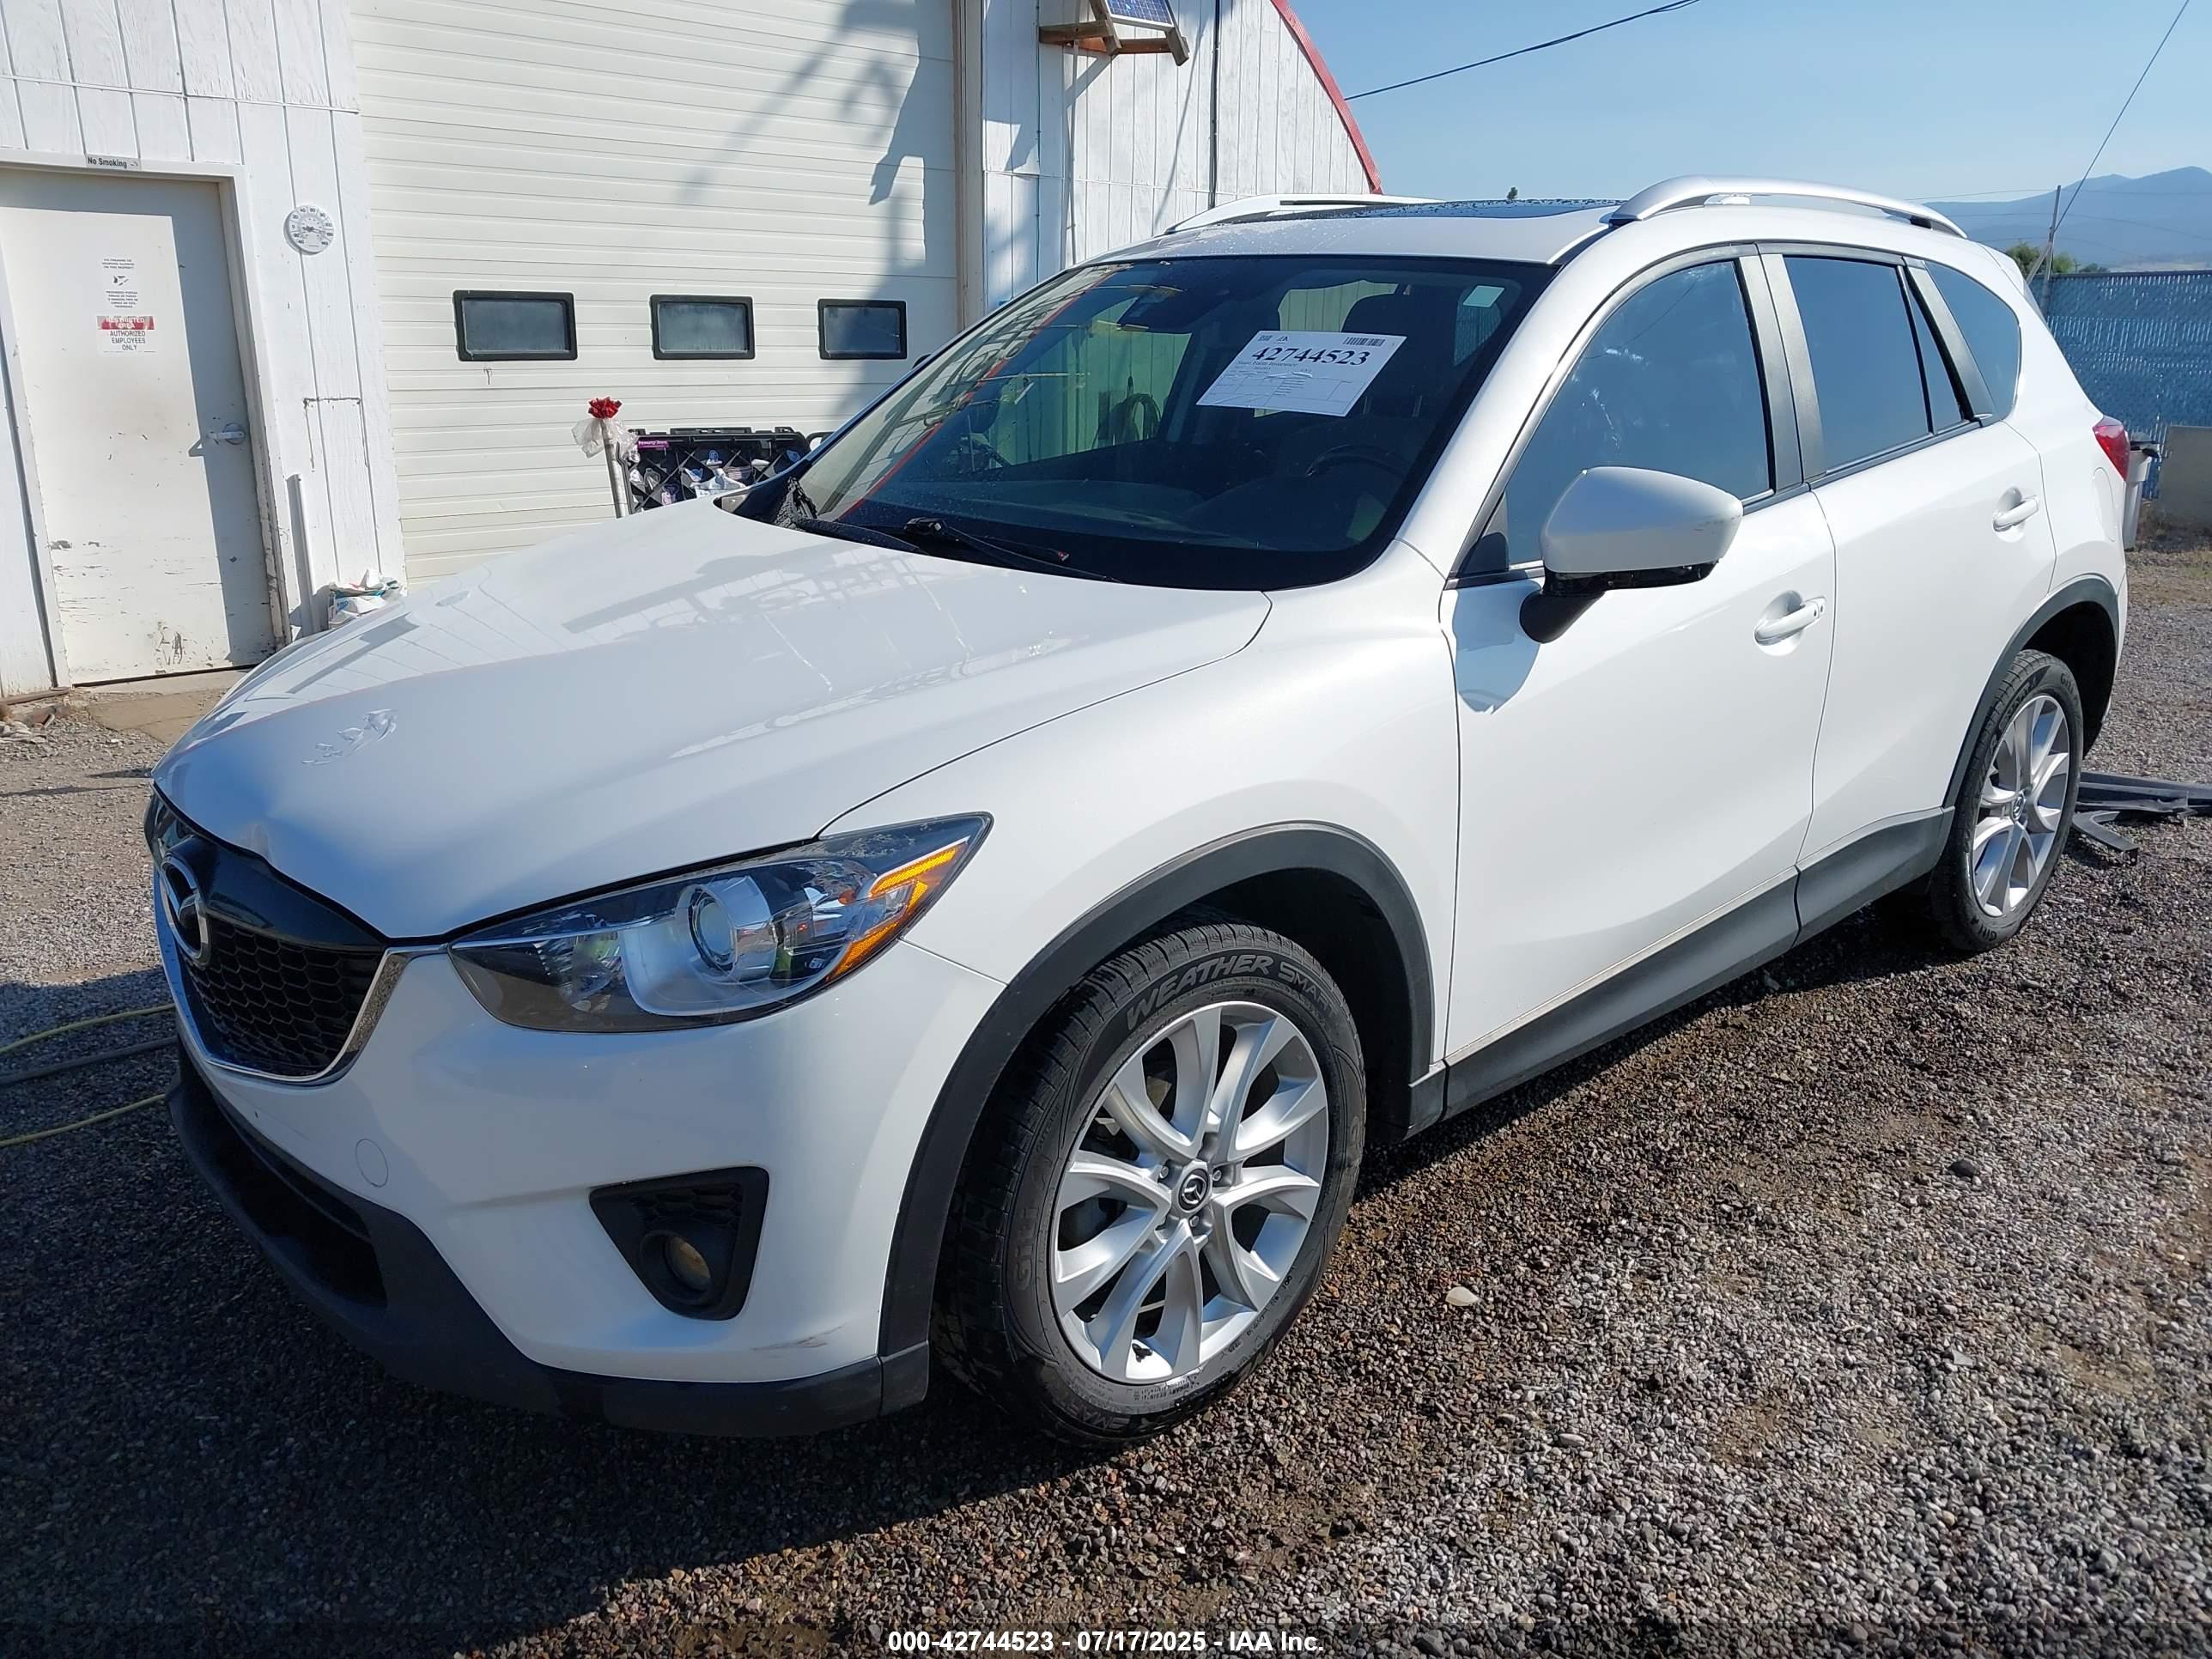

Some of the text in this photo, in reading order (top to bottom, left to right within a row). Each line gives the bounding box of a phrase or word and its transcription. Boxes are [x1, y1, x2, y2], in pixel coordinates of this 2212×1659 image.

[88, 156, 127, 169] No Smoking
[1252, 346, 1370, 366] 42744523
[1127, 954, 1274, 1030] WEATHER
